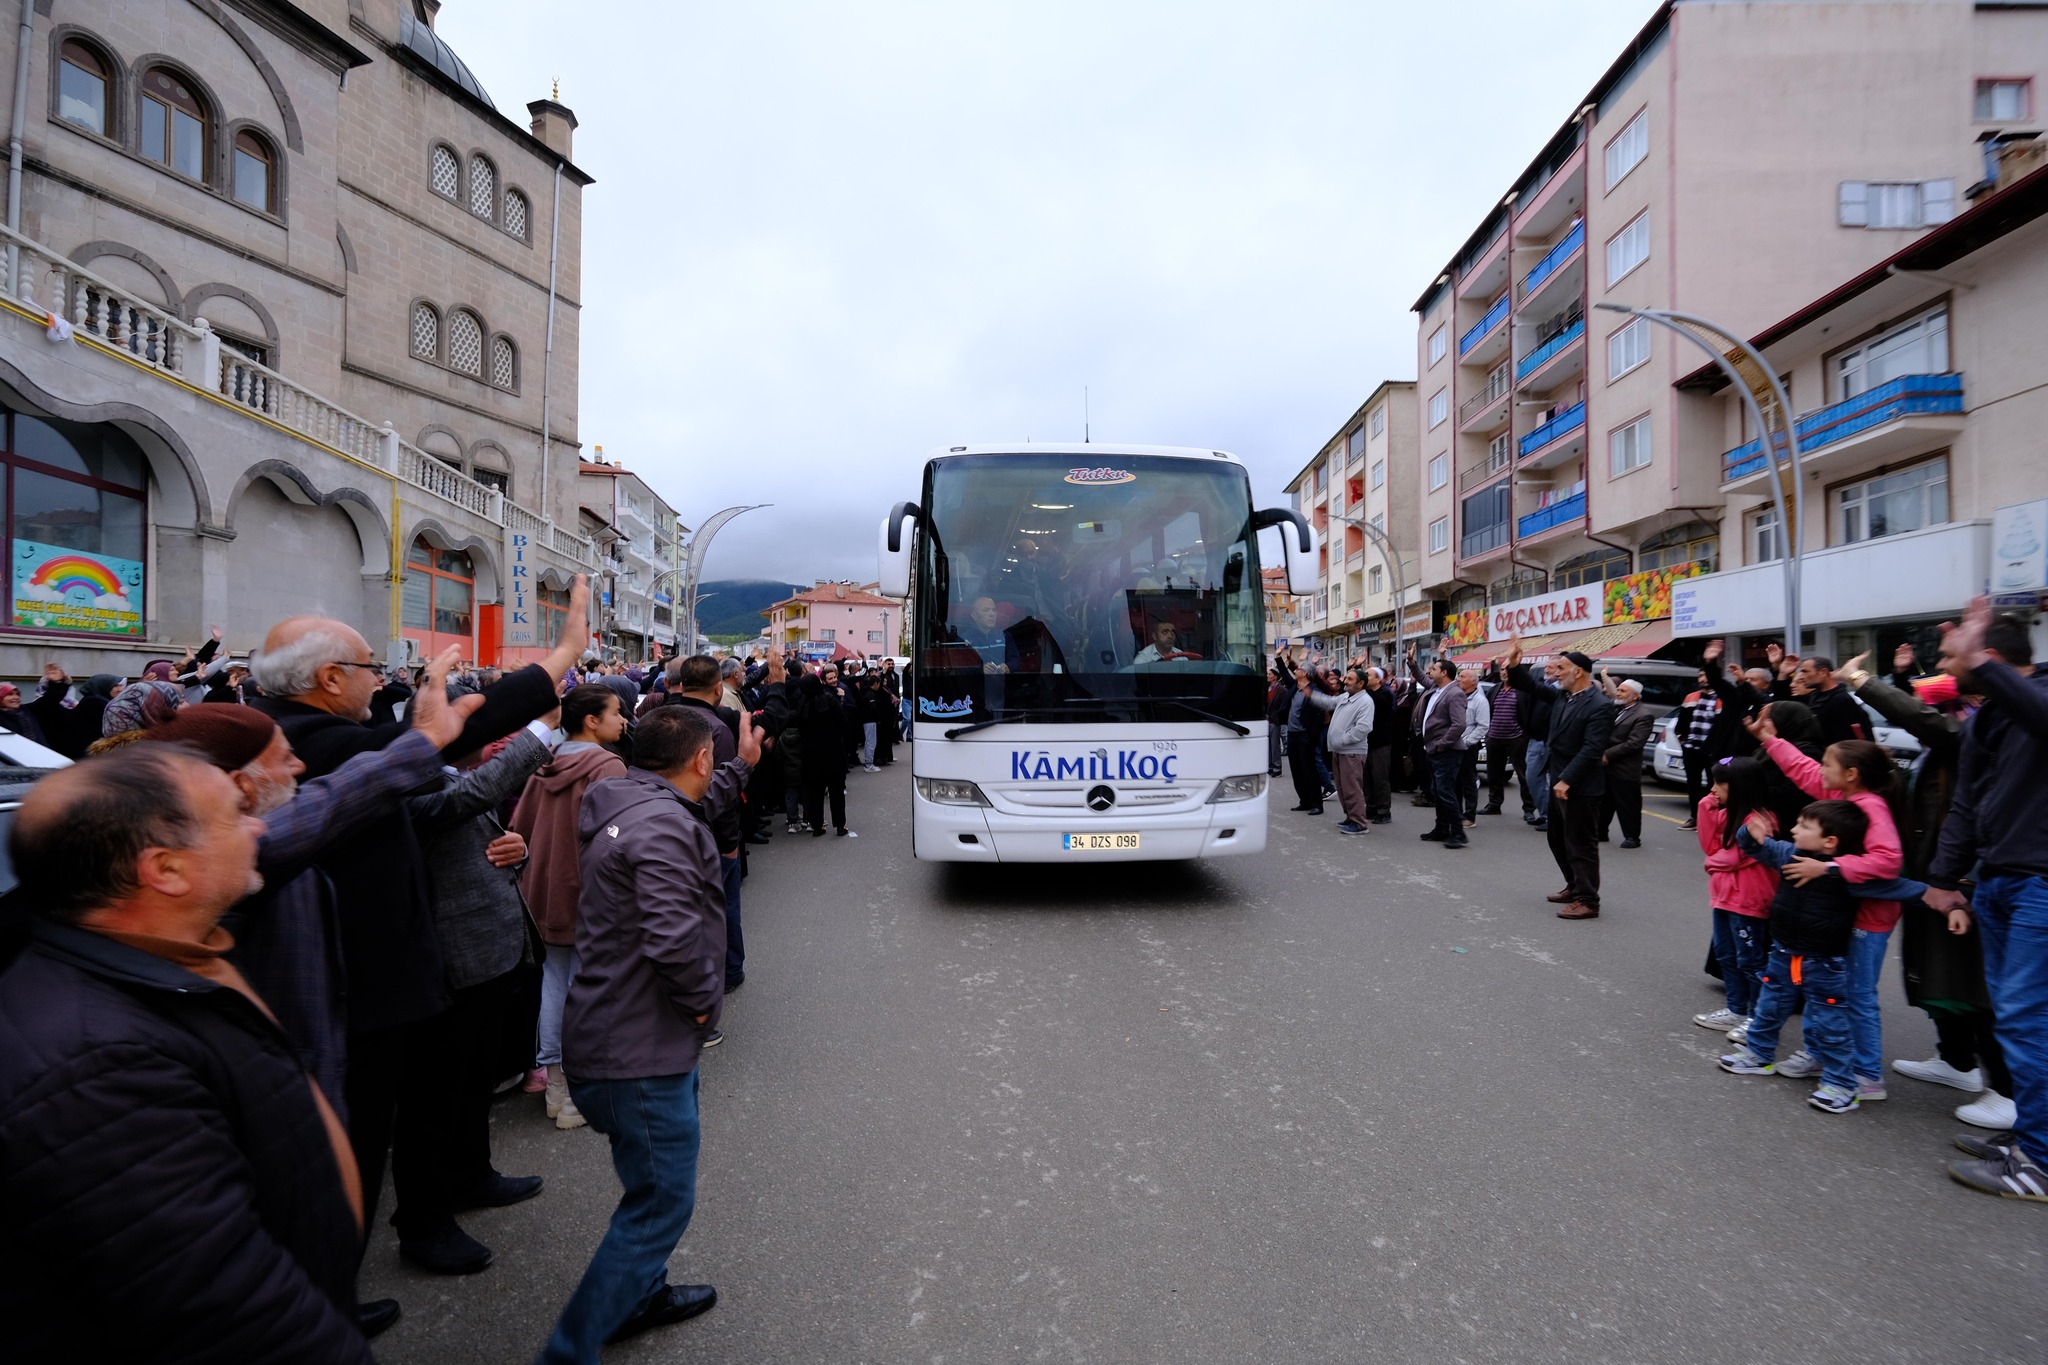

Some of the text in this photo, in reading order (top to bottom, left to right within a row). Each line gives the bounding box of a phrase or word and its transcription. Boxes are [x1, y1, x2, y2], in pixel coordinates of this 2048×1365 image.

[1069, 467, 1127, 481] Tutku
[512, 534, 529, 624] BİRLİK
[1495, 597, 1588, 634] ÖZÇAYLAR
[511, 631, 531, 642] GROSS
[918, 695, 973, 716] Rahat
[1071, 835, 1137, 848] 34 DZS 098
